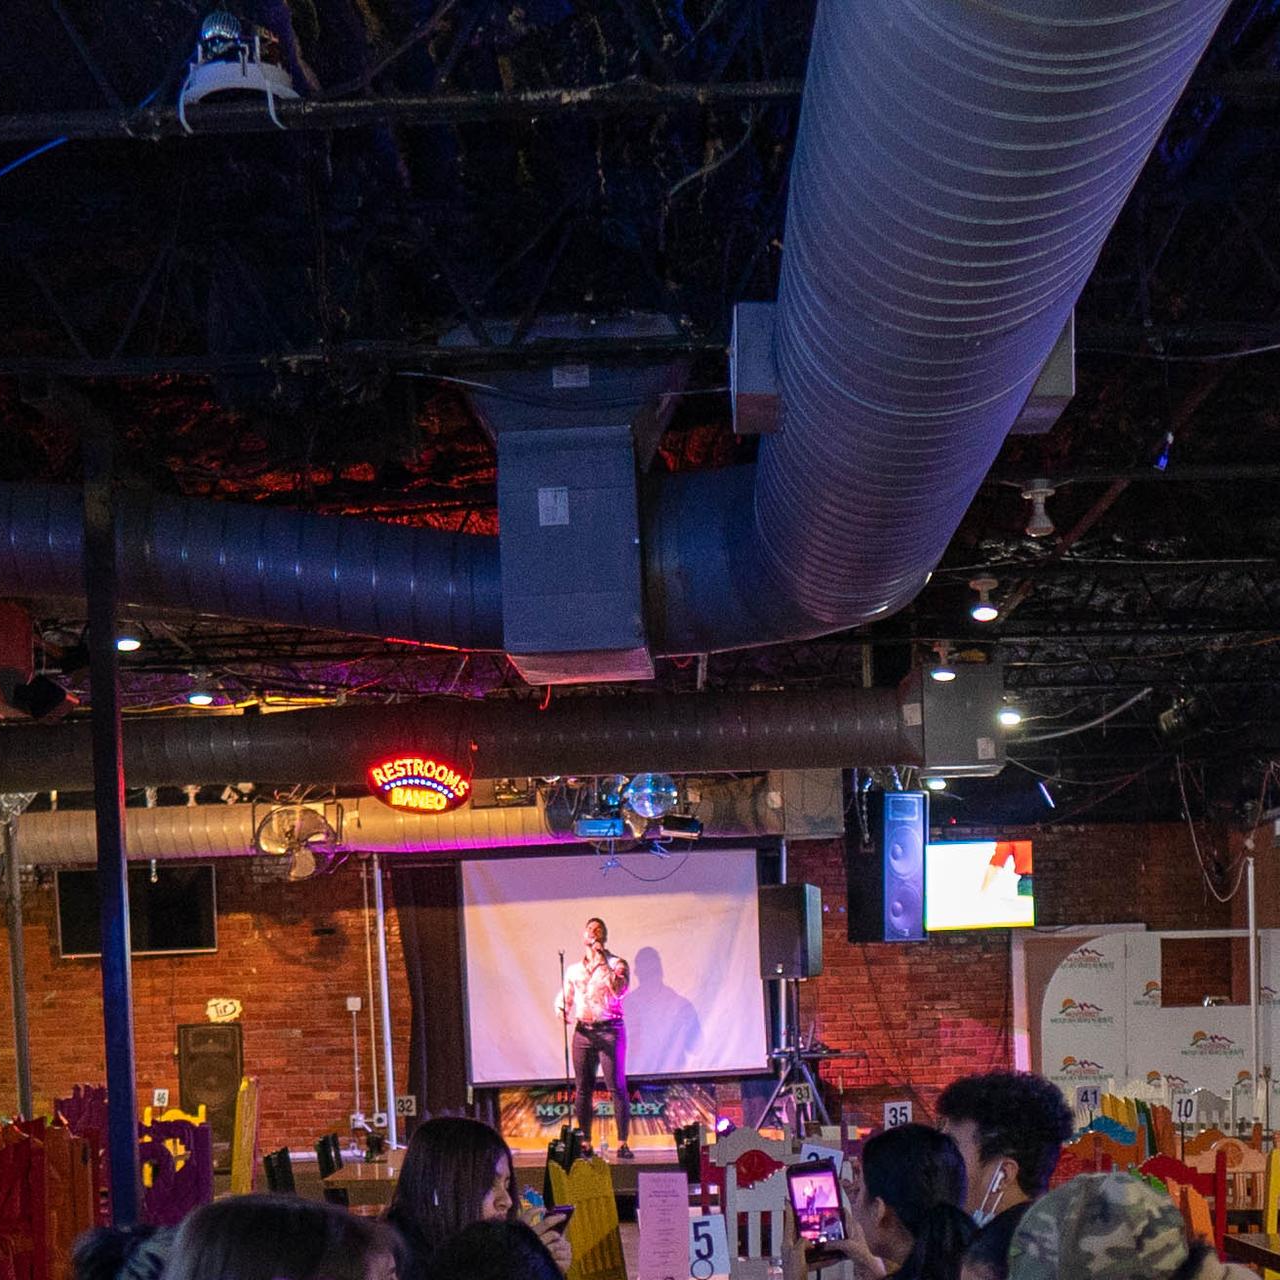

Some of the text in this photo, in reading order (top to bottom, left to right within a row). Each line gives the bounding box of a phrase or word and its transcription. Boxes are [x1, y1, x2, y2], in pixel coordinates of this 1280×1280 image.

[372, 758, 469, 797] RESTROOMS
[397, 1098, 414, 1114] 32
[1080, 1089, 1099, 1105] 41
[888, 1106, 909, 1127] 35
[1176, 1098, 1194, 1119] 10
[692, 1220, 714, 1262] 5
